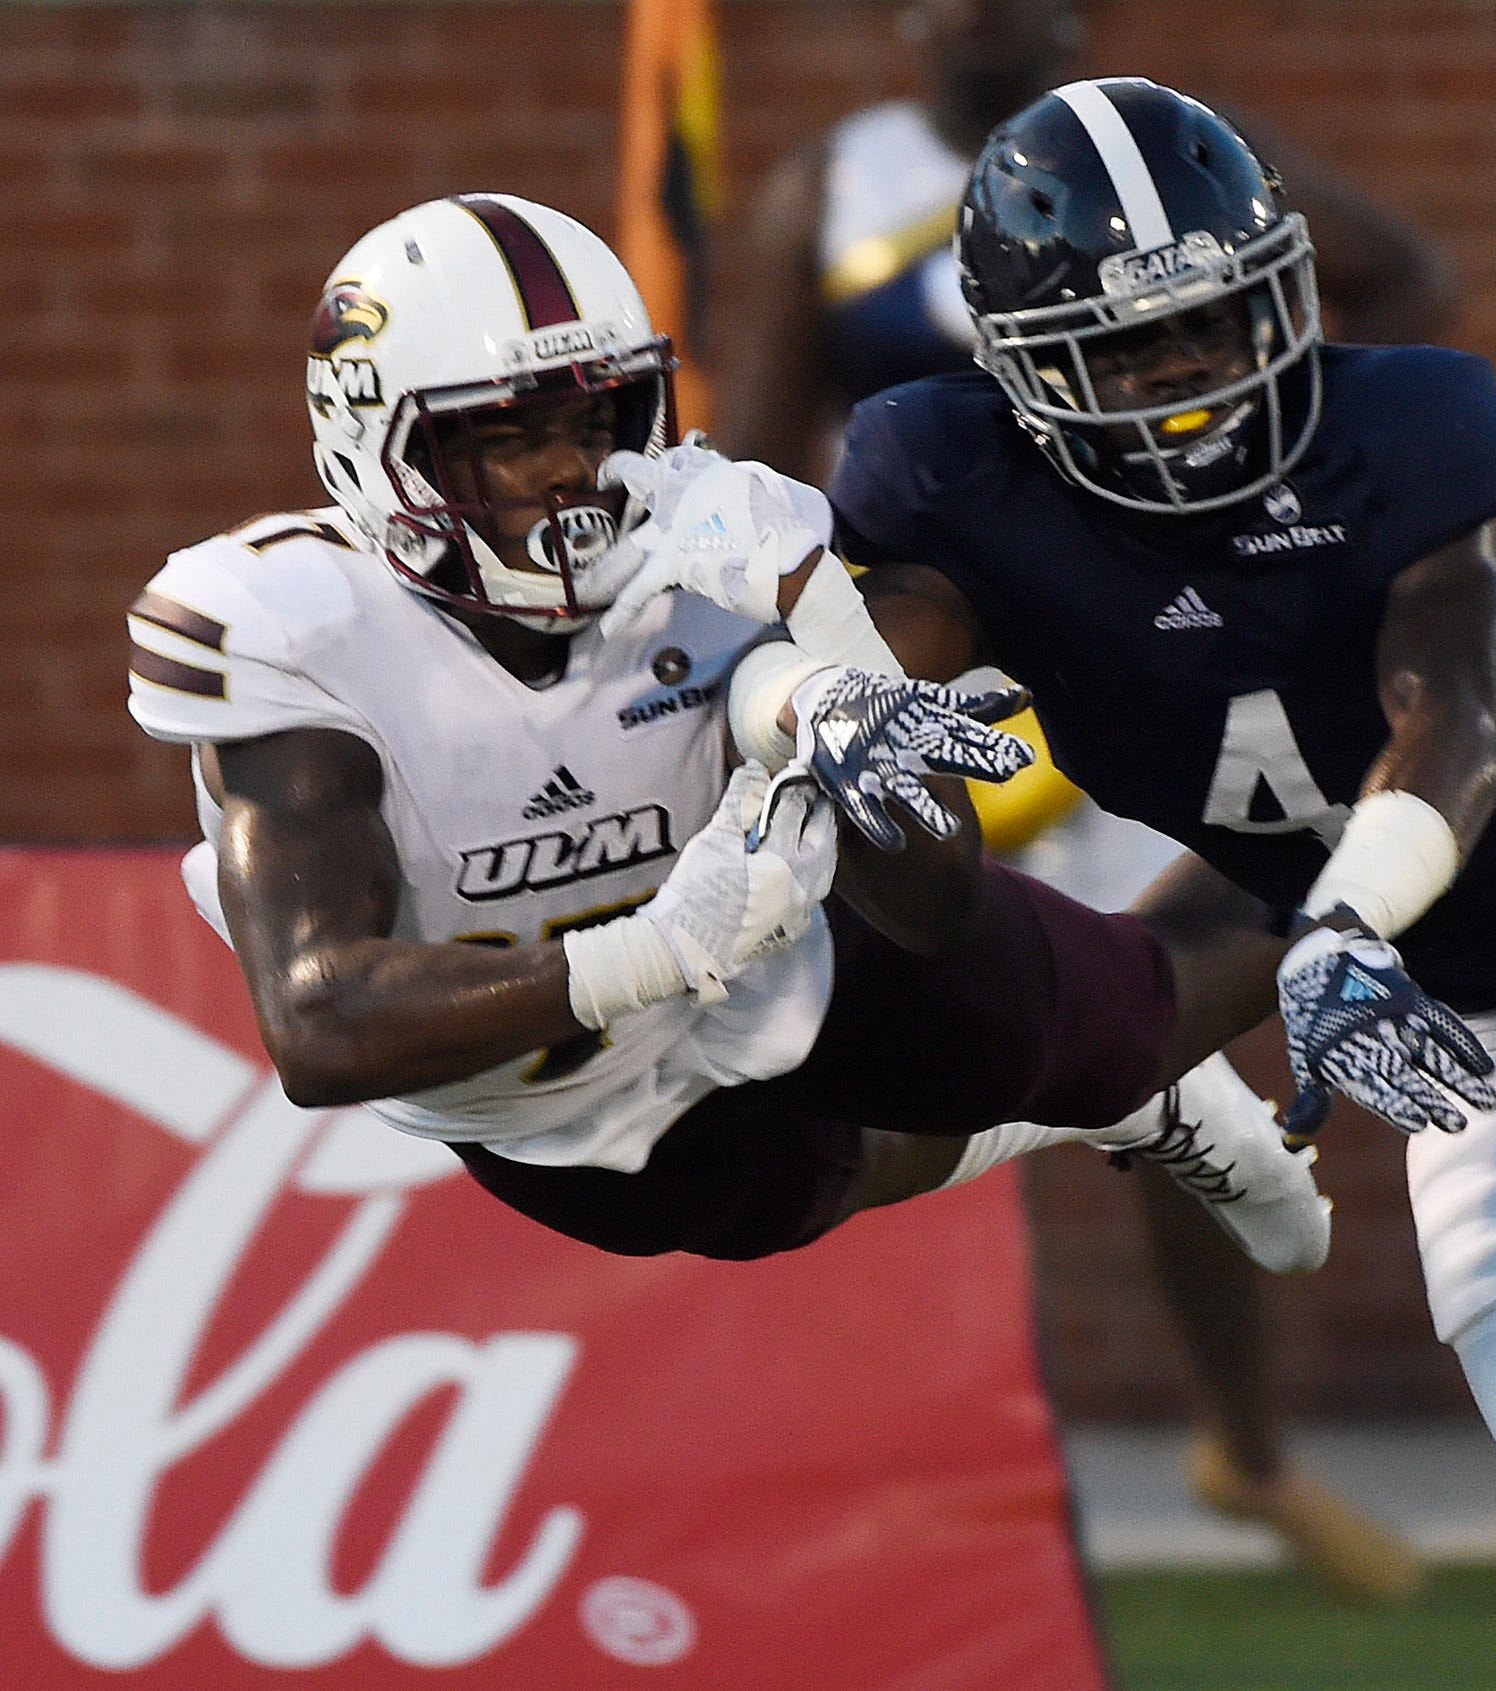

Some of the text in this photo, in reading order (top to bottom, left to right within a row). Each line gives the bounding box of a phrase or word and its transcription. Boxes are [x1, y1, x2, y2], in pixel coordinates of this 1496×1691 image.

[1124, 243, 1198, 288] GATA
[1233, 524, 1346, 555] SUN BELT
[617, 696, 679, 730] SUN
[1203, 688, 1356, 855] 4
[456, 803, 677, 902] ULM
